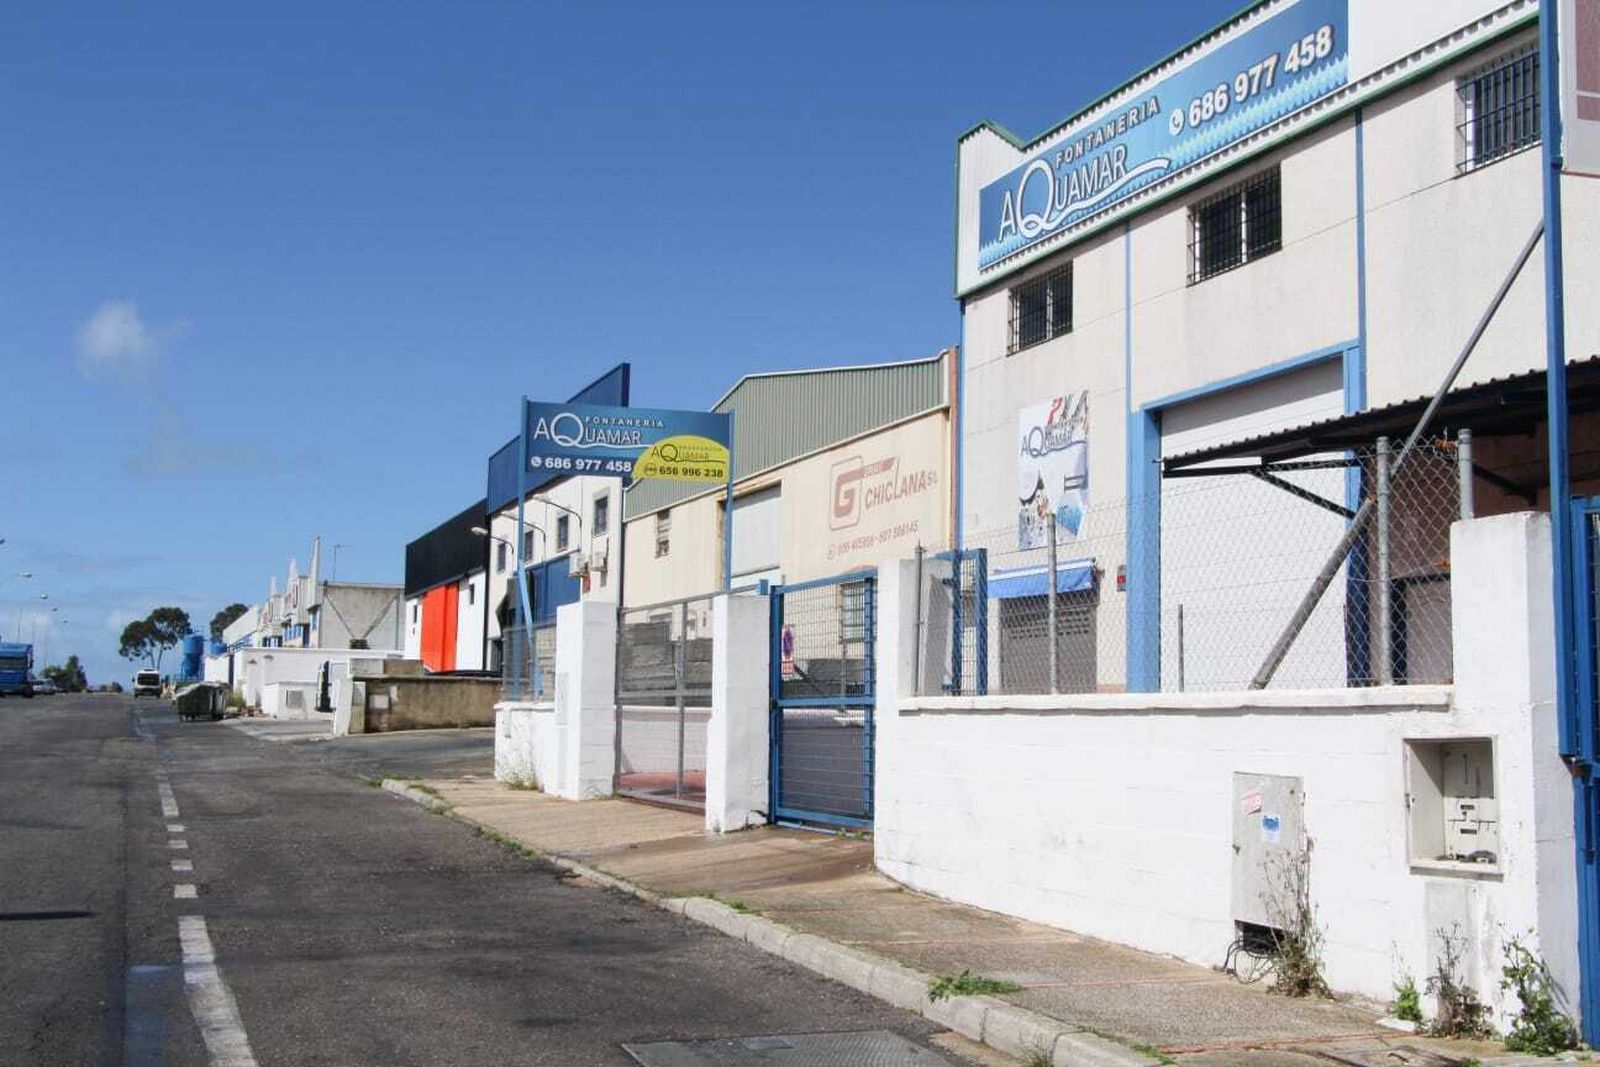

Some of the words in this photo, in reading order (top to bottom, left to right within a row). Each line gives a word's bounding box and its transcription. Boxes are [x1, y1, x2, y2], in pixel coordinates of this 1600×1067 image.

[1188, 82, 1230, 128] 686
[1234, 53, 1281, 103] 977
[1284, 24, 1334, 74] 458
[1055, 96, 1161, 169] FONTANERIA
[1000, 143, 1129, 239] AQUAMAR
[533, 412, 642, 447] AQUAMAR
[585, 415, 664, 428] FONTANERIA
[545, 457, 572, 470] 686
[575, 459, 602, 471] 977
[606, 461, 632, 473] 458
[865, 457, 928, 510] CHICLANA
